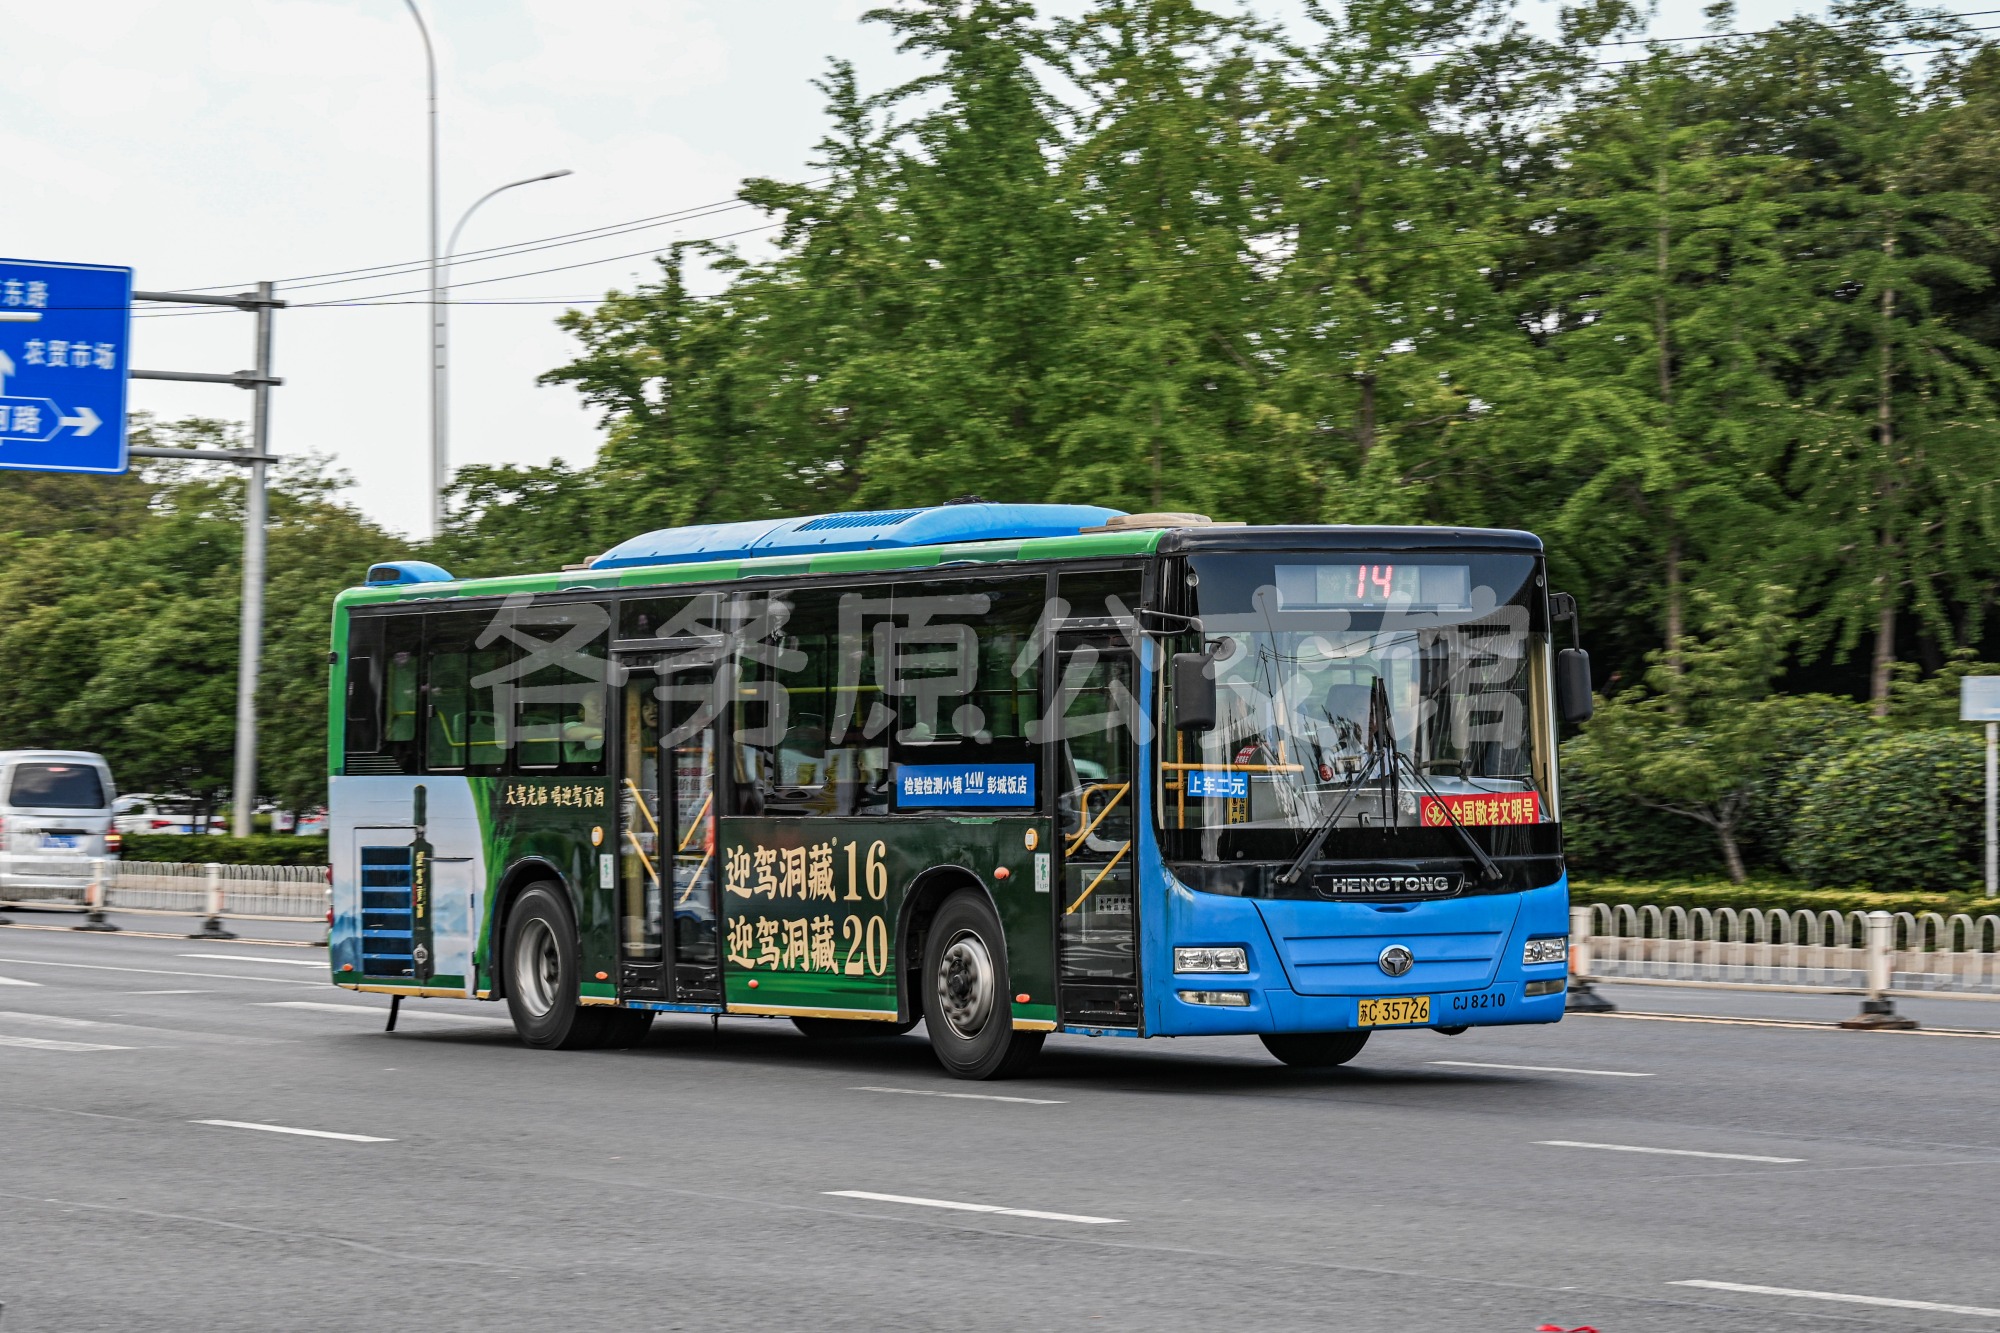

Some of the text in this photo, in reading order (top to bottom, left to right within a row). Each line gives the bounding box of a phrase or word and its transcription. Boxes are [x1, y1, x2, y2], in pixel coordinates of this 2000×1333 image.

[0, 278, 49, 308] 东路
[22, 338, 116, 370] 农贸市场
[1357, 565, 1392, 599] 14
[904, 771, 1027, 795] 检验检测小镇 14W 彭城饭店
[1190, 776, 1245, 795] 上车二元
[1451, 798, 1534, 826] 全国敬老文明号
[1332, 876, 1449, 893] HENGTONG
